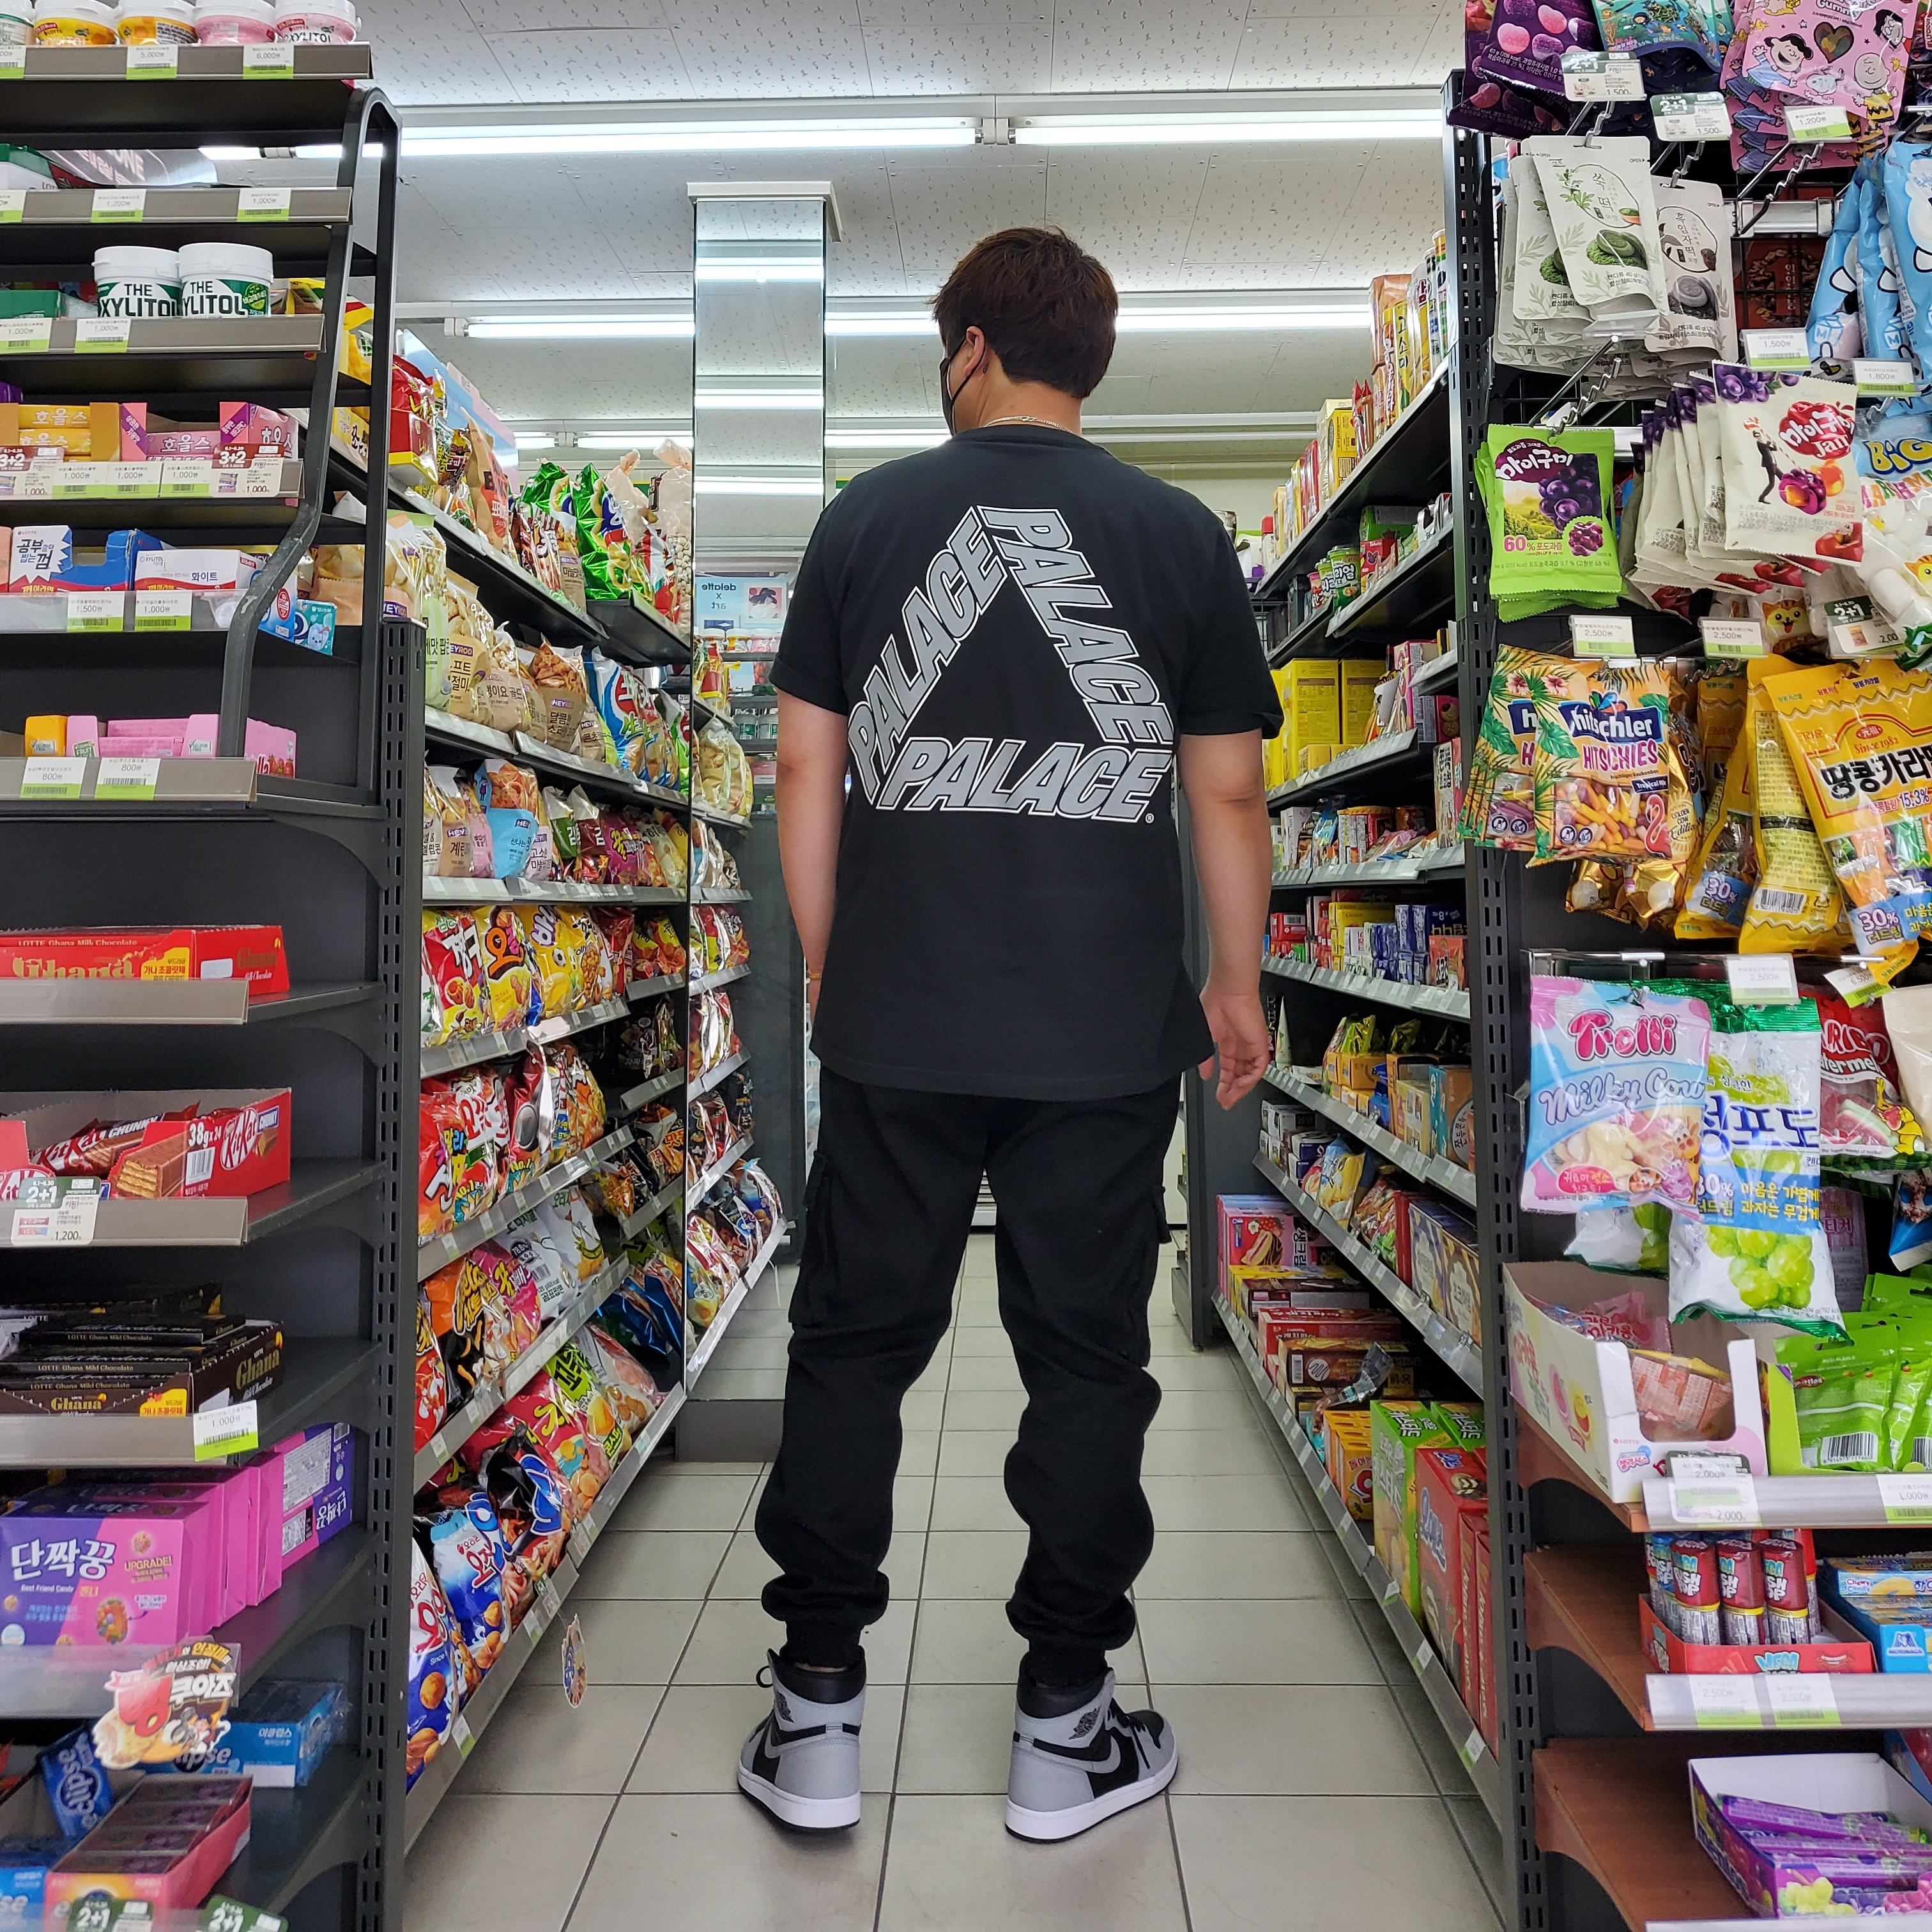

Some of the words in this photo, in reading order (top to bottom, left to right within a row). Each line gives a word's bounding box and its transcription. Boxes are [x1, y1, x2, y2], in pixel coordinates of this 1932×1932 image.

[1659, 98, 1689, 112] 2+1
[124, 284, 153, 296] THE
[190, 280, 213, 294] THE
[1763, 340, 1791, 348] 1,500원
[33, 408, 89, 426] 호올스
[161, 434, 211, 453] 호올스
[218, 451, 246, 464] 3+2
[1495, 448, 1574, 480] 마이구미
[17, 539, 44, 553] 공부
[1537, 542, 1563, 551] 포도과즙
[35, 550, 54, 571] 껌
[191, 571, 218, 582] 화이트
[1834, 605, 1864, 620] 2+1
[977, 505, 1174, 744] PALACE
[1584, 629, 1613, 638] 2,500원
[1713, 631, 1742, 640] 2,500원
[848, 506, 1009, 805] PALACE
[1570, 705, 1653, 738] hitschler
[1854, 740, 1880, 755] Since
[1880, 735, 1899, 749] 1982
[1583, 738, 1659, 772] HITSCHIES
[42, 772, 63, 781] 800원
[121, 763, 141, 772] 800원
[875, 737, 1173, 824] PALACE
[1671, 809, 1690, 819] GOLDEN
[1705, 877, 1738, 903] 30%
[1858, 910, 1899, 932] 30%
[143, 966, 157, 974] 가나
[1567, 1008, 1678, 1061] Trolli
[1538, 1073, 1641, 1126] Milky
[1646, 1067, 1707, 1102] Cow
[108, 1115, 160, 1138] CHUNKY
[26, 1186, 57, 1204] 2+1
[1740, 1181, 1779, 1199] 마음은
[235, 1348, 280, 1390] Ghana
[50, 1397, 102, 1411] Ghana
[211, 1414, 241, 1429] 1,000원
[10, 1537, 116, 1582] 단짝꿍
[124, 1555, 173, 1571] UPGRADE!
[1846, 1577, 1871, 1587] Chewy
[1754, 1651, 1800, 1672] MEGA
[77, 1906, 111, 1929] 2+1
